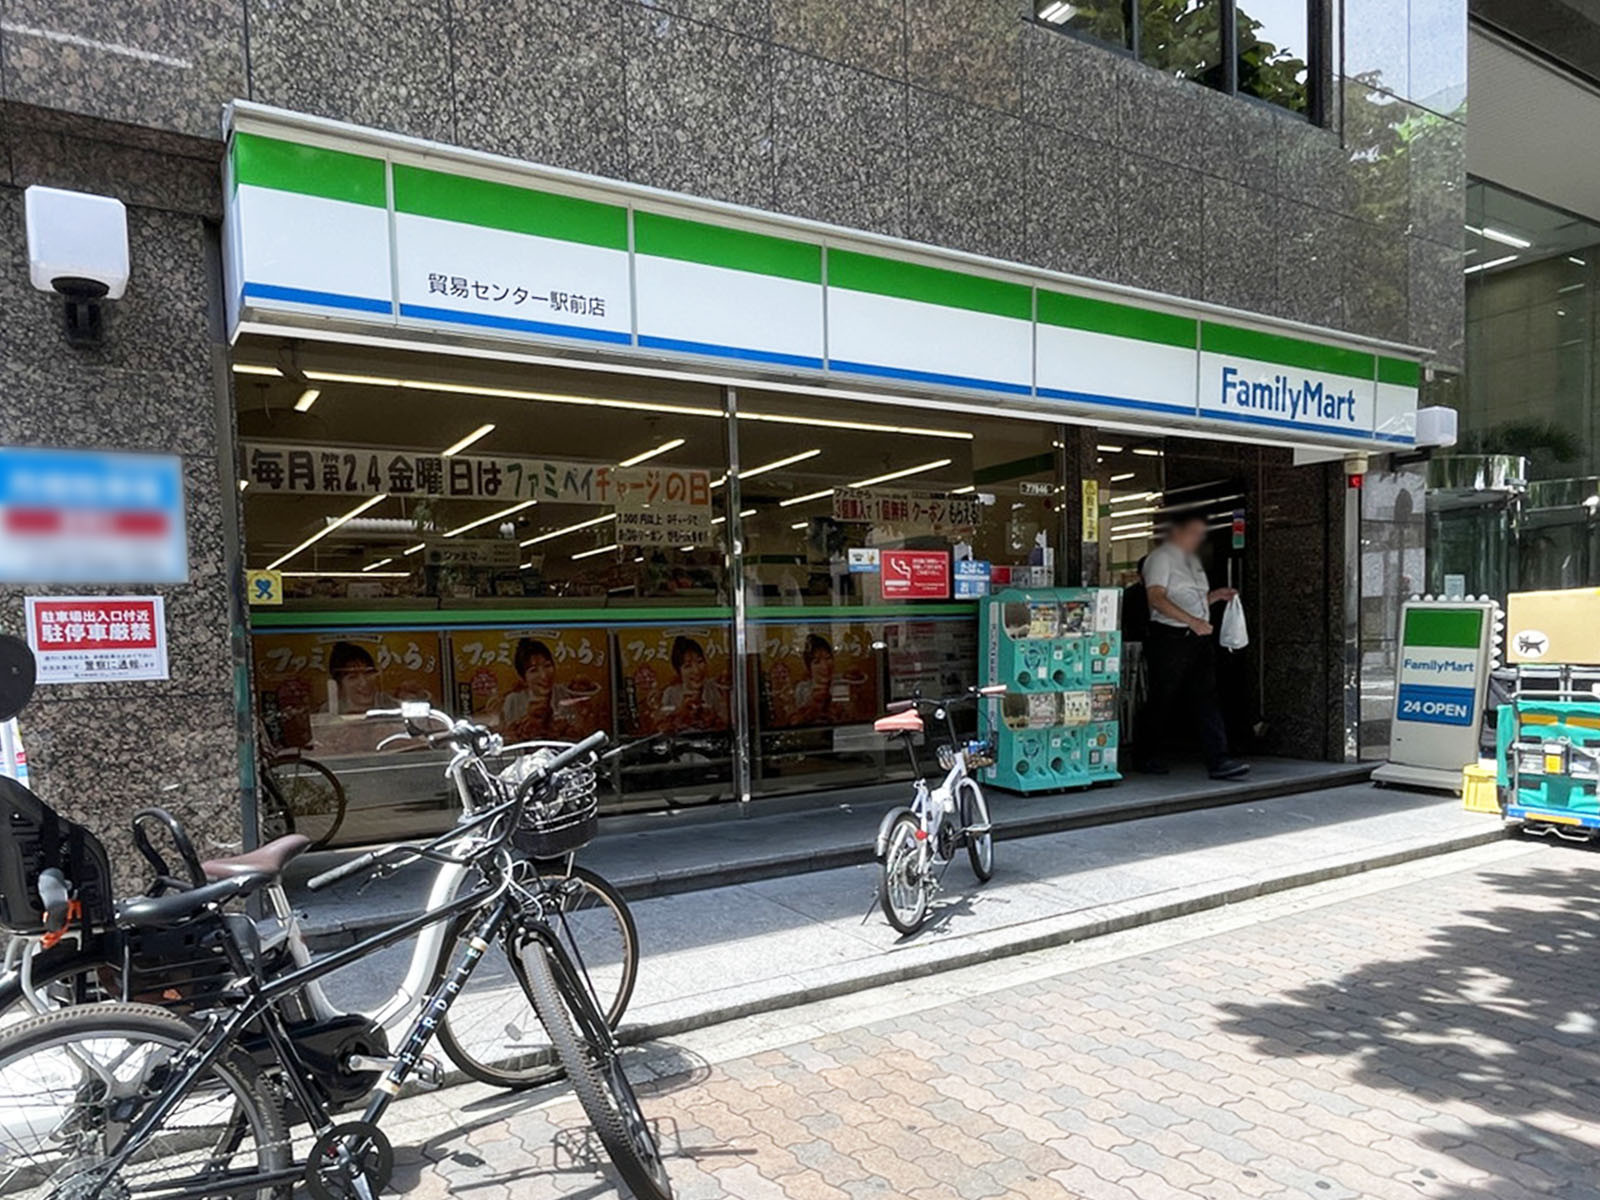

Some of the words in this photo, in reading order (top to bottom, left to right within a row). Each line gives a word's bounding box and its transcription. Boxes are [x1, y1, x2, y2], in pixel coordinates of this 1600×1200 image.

[428, 273, 606, 317] 貿易センター駅前店
[1222, 366, 1356, 422] FamilyMart
[41, 609, 150, 622] 駐車場出入口付近
[41, 622, 152, 643] 駐停車厳禁
[1403, 658, 1475, 674] FamilyMart
[1402, 700, 1421, 713] 24
[1423, 701, 1467, 718] OPEN
